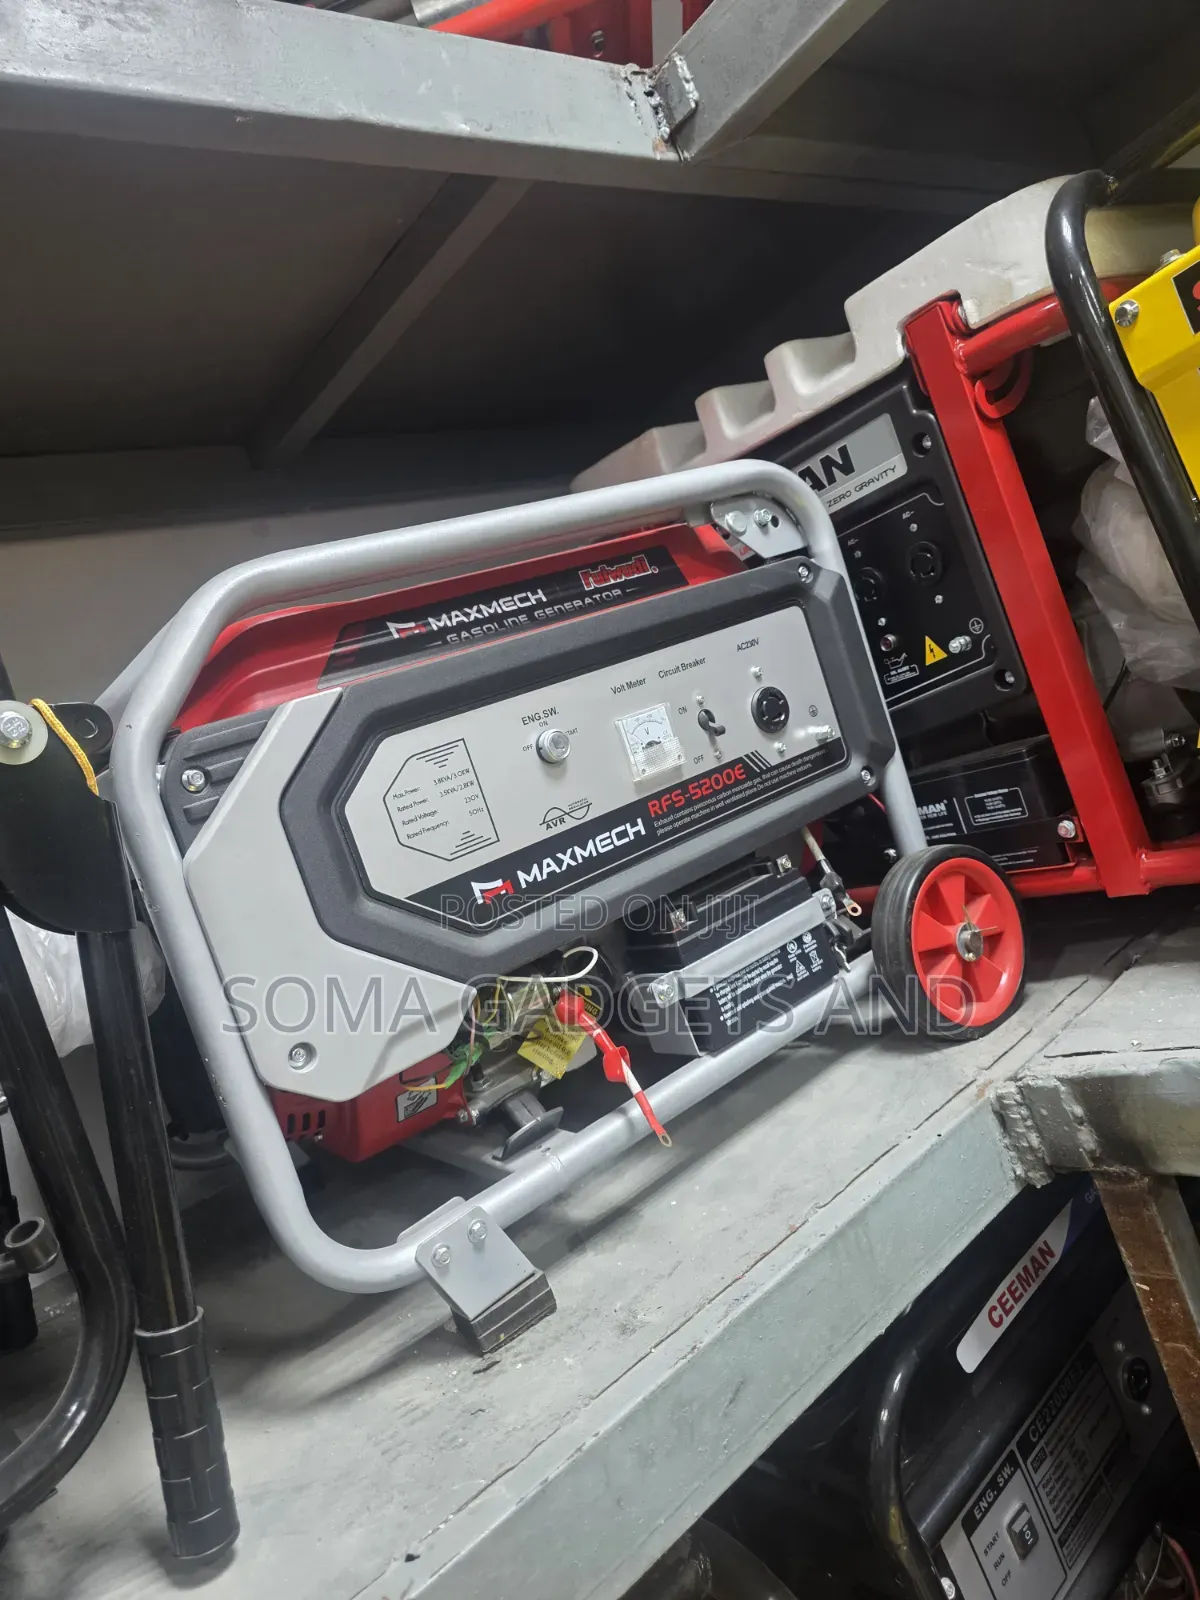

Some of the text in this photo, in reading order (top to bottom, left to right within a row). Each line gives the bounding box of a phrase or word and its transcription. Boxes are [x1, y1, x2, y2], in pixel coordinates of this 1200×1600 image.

[827, 465, 897, 508] ZERO GRAVITY
[428, 588, 547, 631] MAXMECH
[446, 588, 624, 645] GASOLINE GENERATOR
[736, 637, 760, 652] AC230V
[658, 657, 706, 679] Circuit Breaker
[610, 677, 647, 695] Volt Meter
[521, 706, 560, 726] ENG.SW.
[678, 706, 688, 715] ON
[565, 727, 579, 737] TART
[644, 727, 650, 736] V
[522, 744, 534, 752] OFF
[693, 754, 705, 765] OFF
[647, 763, 747, 818] RFS-5200E
[397, 800, 413, 812] Rated
[413, 797, 430, 808] Power:
[401, 794, 479, 826] Rated Voltage: 230V
[652, 813, 674, 827] Exhaust
[672, 806, 693, 818] contains
[715, 788, 732, 800] carbon
[406, 829, 423, 840] Rated
[422, 820, 450, 834] Frequency:
[545, 817, 566, 831] AVR
[655, 823, 673, 836] please
[672, 815, 691, 828] operate
[516, 817, 647, 889] MAXMECH
[988, 1240, 1056, 1328] CEEMAN
[973, 1462, 1014, 1520] ENG. SW.
[984, 1531, 1000, 1556] START
[993, 1552, 1005, 1571] RUN
[1001, 1569, 1011, 1587] OFF
